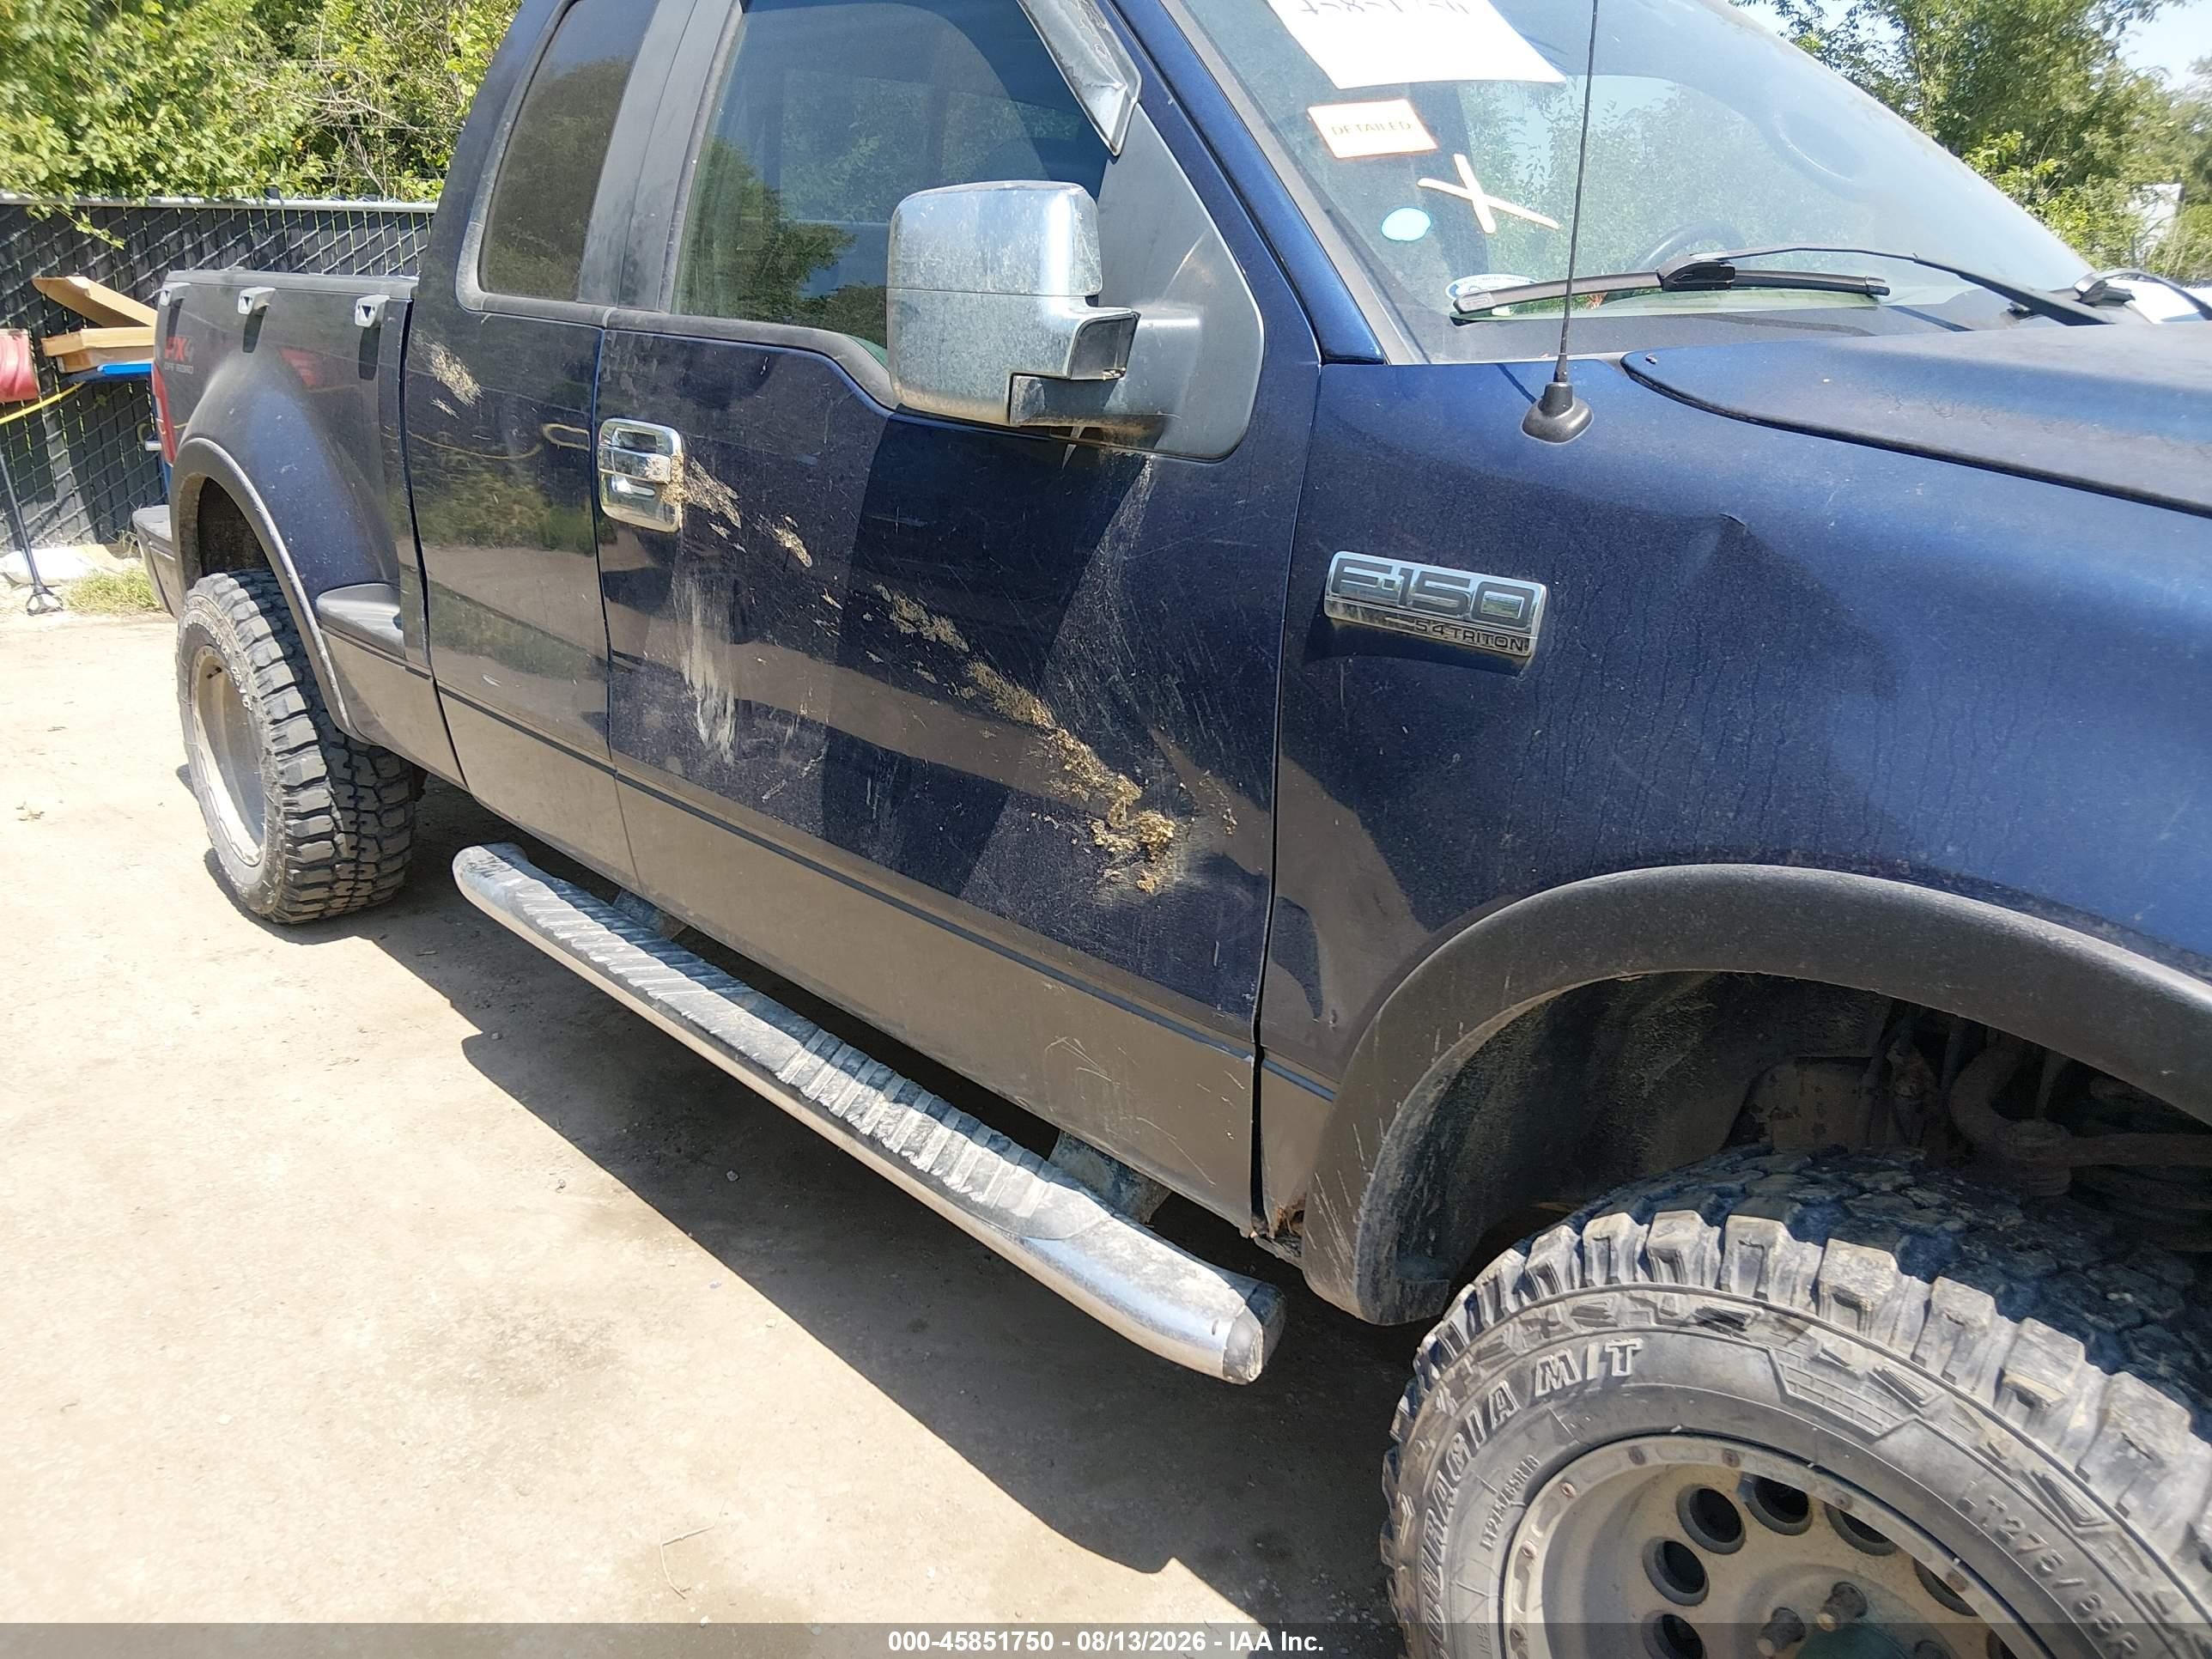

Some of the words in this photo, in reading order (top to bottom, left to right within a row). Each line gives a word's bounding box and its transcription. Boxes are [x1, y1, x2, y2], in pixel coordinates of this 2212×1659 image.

[1332, 119, 1413, 137] DETAILED
[1449, 627, 1523, 653] TRITON
[1419, 1380, 1521, 1659] OURAGIA
[1534, 1337, 1644, 1397] M/T
